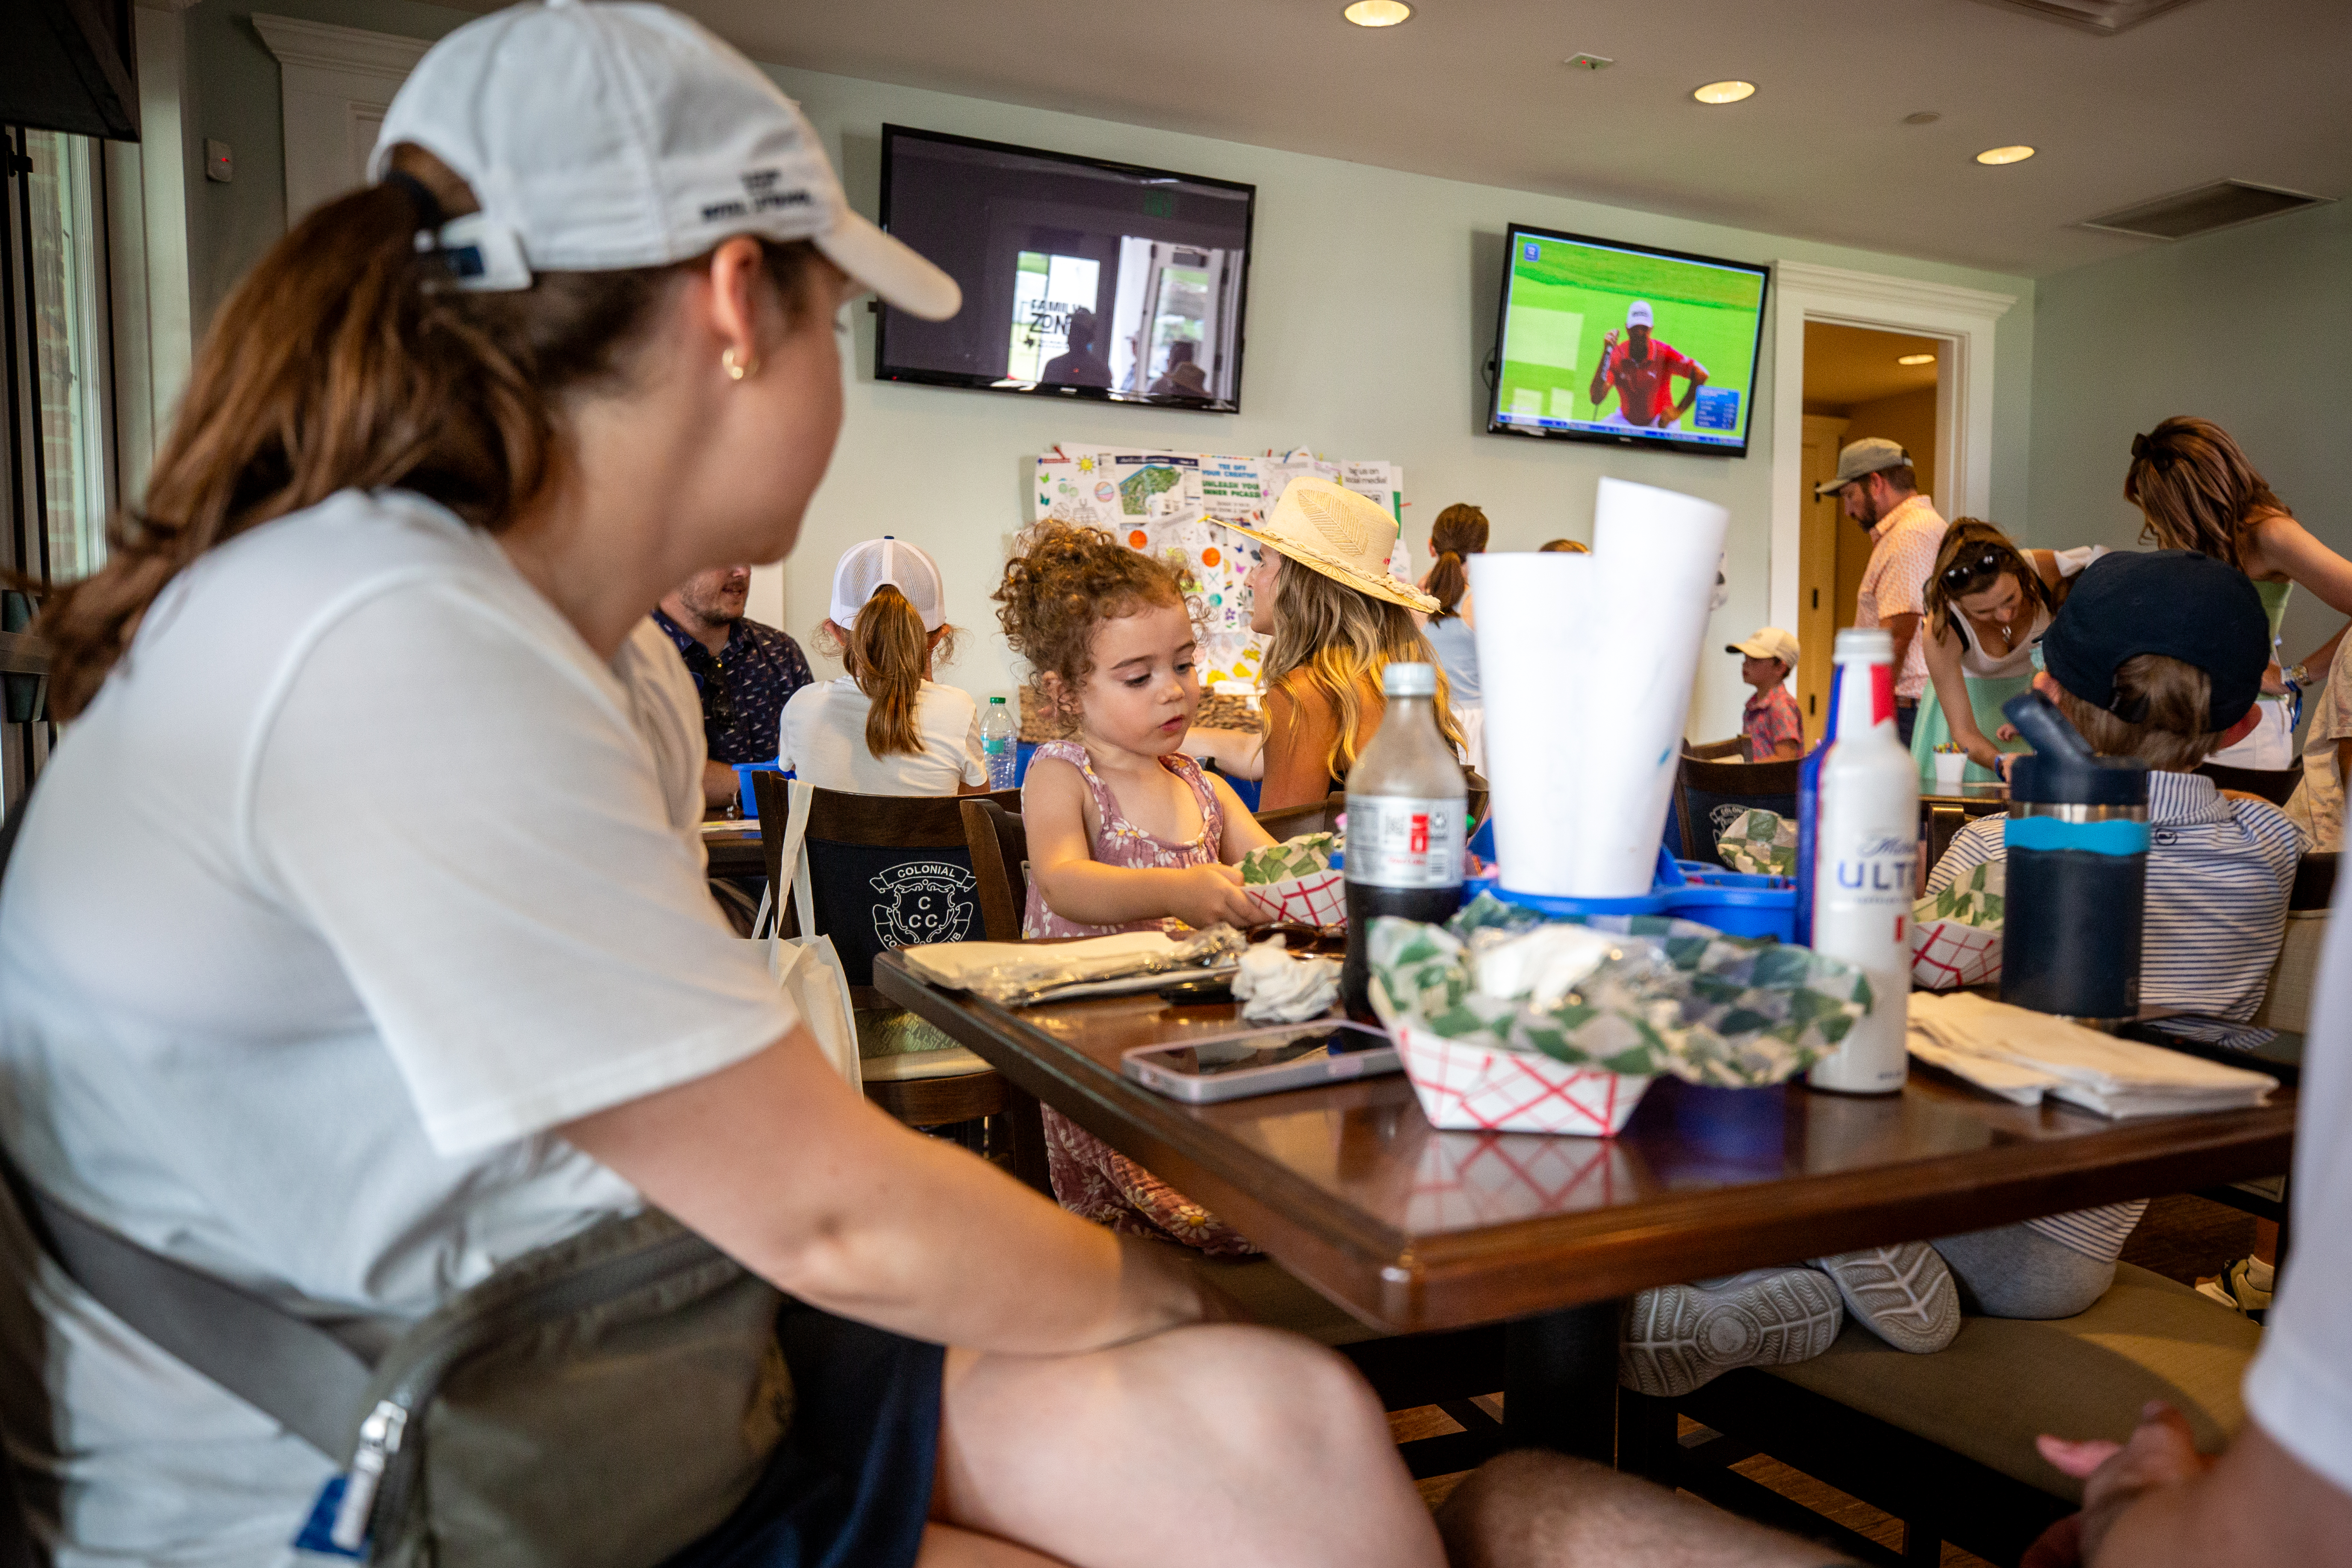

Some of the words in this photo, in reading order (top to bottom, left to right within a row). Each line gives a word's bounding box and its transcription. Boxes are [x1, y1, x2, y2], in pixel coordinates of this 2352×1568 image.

[1030, 312, 1071, 335] ZON
[1202, 480, 1238, 488] UNLEASH
[898, 865, 955, 878] COLONIAL
[918, 897, 931, 910] C
[909, 914, 921, 928] C
[925, 914, 938, 927] C
